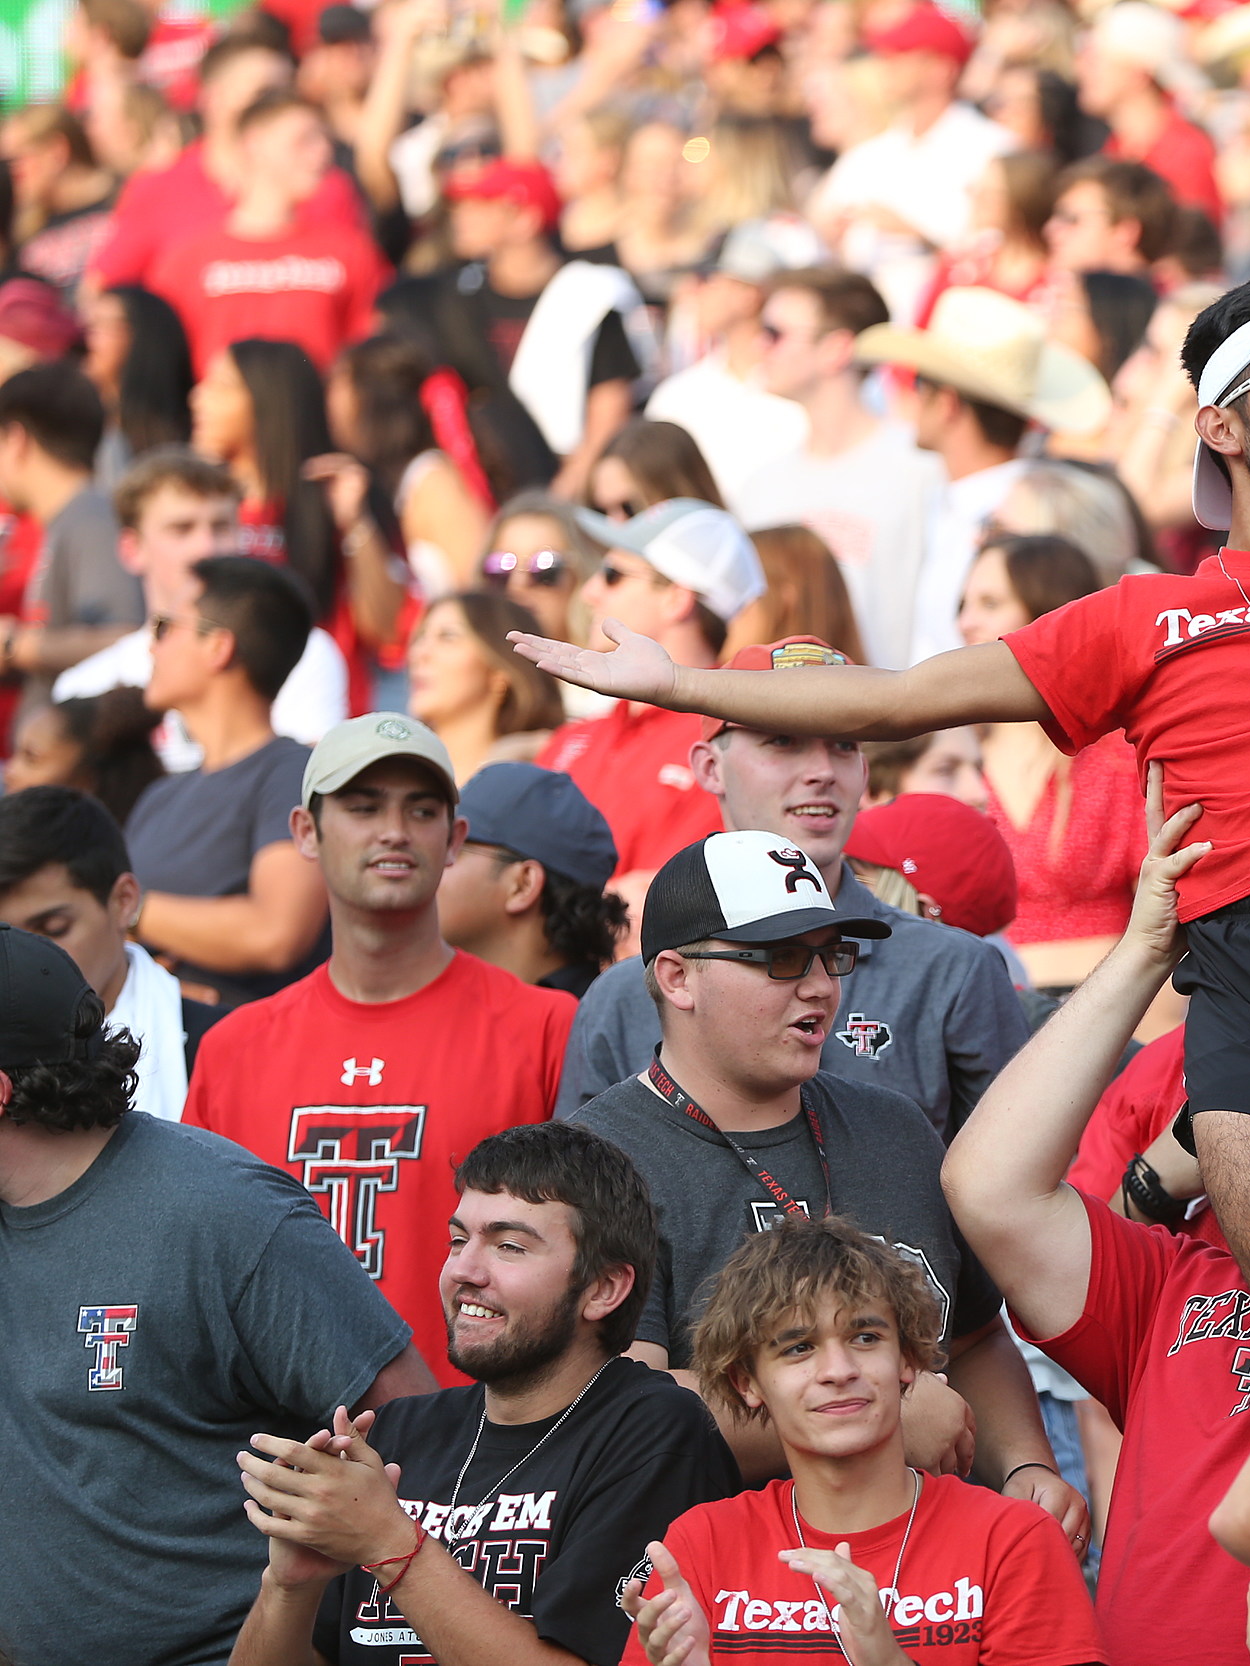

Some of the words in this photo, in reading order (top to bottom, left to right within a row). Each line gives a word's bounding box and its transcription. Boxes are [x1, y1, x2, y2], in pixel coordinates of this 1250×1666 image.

[656, 1072, 676, 1098] TECH
[757, 1170, 788, 1201] TEXAS
[397, 1498, 495, 1541] RECK
[489, 1490, 558, 1532] EM
[714, 1589, 841, 1632] Texa
[367, 1630, 394, 1643] JONES
